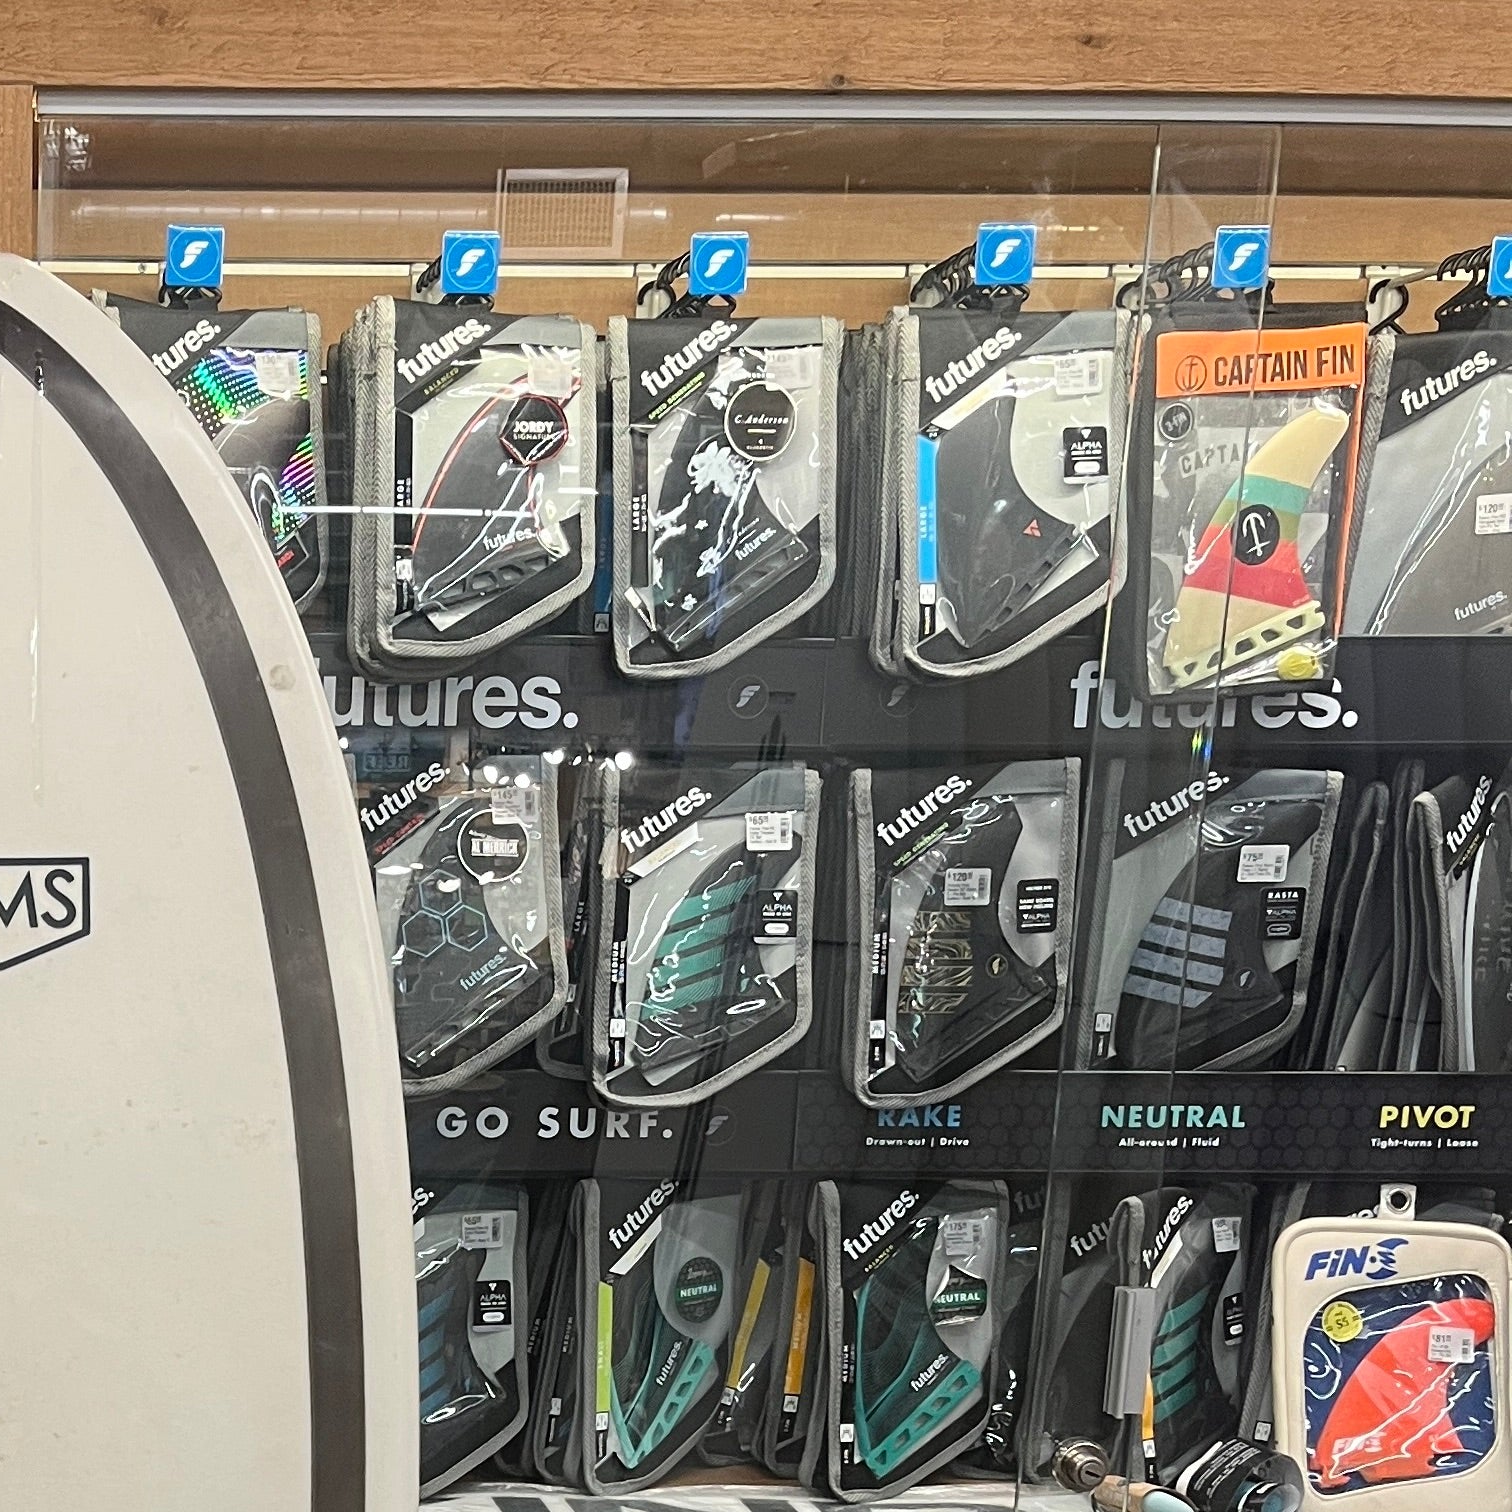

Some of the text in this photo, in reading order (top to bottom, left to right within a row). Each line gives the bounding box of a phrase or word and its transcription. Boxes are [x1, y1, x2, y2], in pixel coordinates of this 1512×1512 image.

[397, 317, 491, 384] futures.
[640, 320, 738, 396] futures.
[925, 326, 1022, 402] futures.
[1213, 344, 1355, 387] CAPTAIN FIN
[1400, 349, 1497, 417] futures.
[513, 420, 554, 432] JORDY
[1070, 441, 1102, 450] ALPHA
[1453, 589, 1508, 622] futures.
[360, 760, 451, 832] futures.
[877, 772, 973, 847] futures.
[1124, 770, 1230, 838] futures.
[1446, 775, 1493, 854] futures.
[620, 786, 713, 854] futures.
[762, 902, 793, 912] ALPHA
[1267, 890, 1299, 900] RASTA
[460, 951, 509, 992] futures.
[437, 1106, 673, 1140] GO SURF.
[878, 1104, 962, 1129] RAKE
[1100, 1104, 1246, 1129] NEUTRAL
[1379, 1105, 1476, 1130] PIVOT
[939, 1134, 969, 1144] Drive
[1191, 1137, 1220, 1148] Fluid
[1370, 1138, 1479, 1150] Tight-turns Loose
[609, 1177, 680, 1250] futures.
[843, 1187, 920, 1261] futures.
[479, 1293, 507, 1303] ALPHA
[679, 1282, 718, 1298] NEUTRAL
[655, 1338, 684, 1386] futures.
[911, 1353, 949, 1392] futures.
